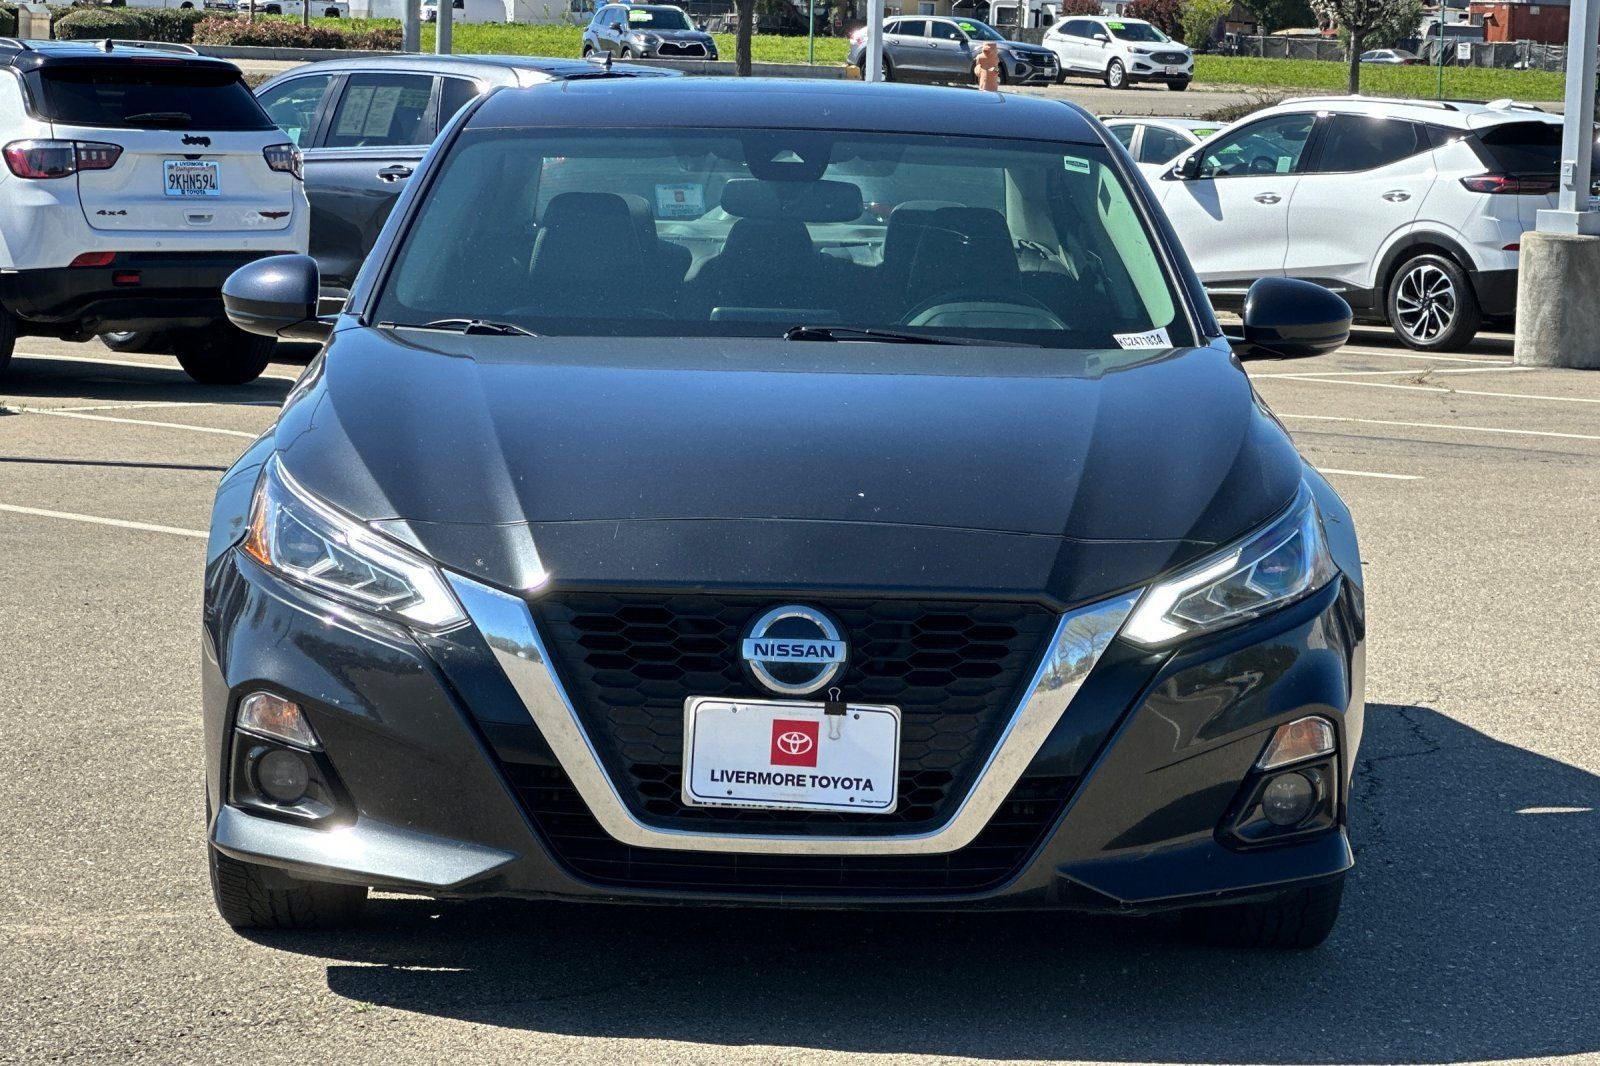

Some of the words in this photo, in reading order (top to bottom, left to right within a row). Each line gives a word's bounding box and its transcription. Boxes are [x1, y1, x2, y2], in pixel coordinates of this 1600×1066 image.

[181, 134, 211, 147] Jeep
[169, 174, 216, 190] 9KHN594
[754, 643, 835, 658] NISSAN
[710, 769, 806, 787] LIVERMORE
[810, 775, 874, 791] TOYOTA
